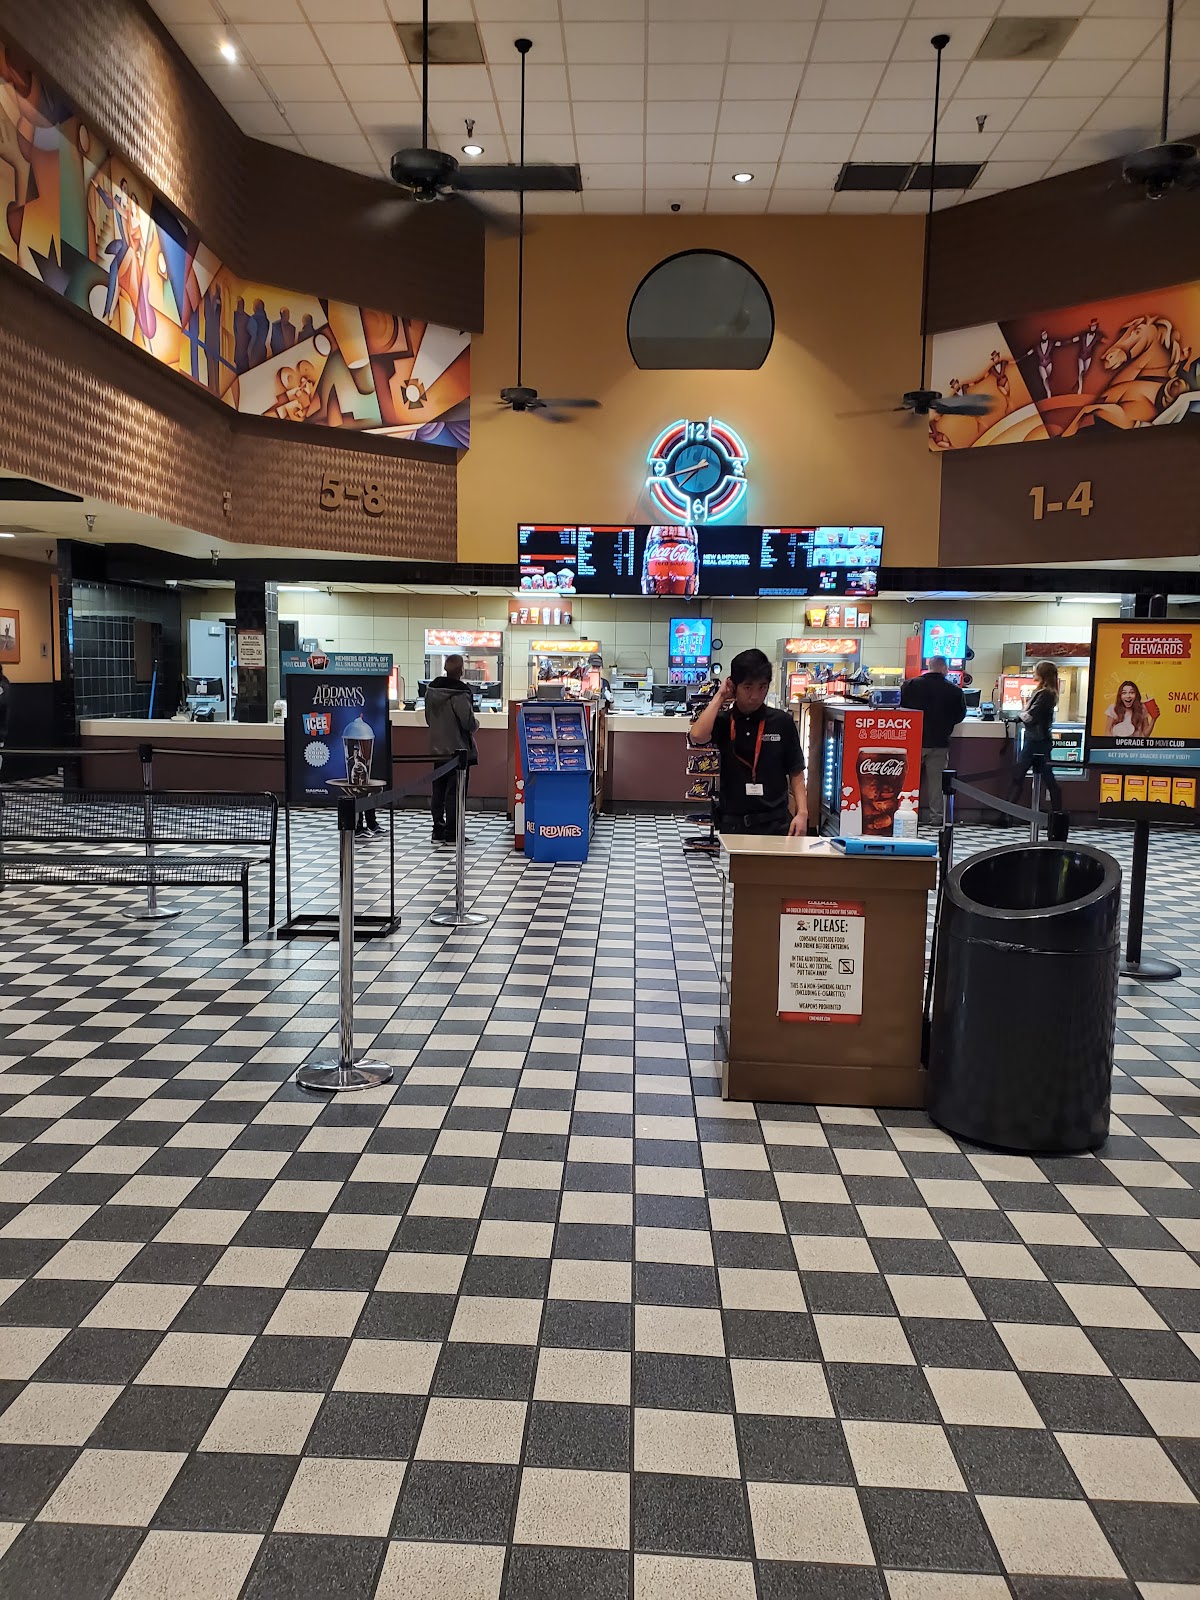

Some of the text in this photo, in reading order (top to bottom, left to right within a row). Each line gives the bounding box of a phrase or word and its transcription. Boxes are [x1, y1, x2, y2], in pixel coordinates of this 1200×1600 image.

[689, 422, 704, 438] 12
[654, 461, 666, 476] 9
[733, 460, 744, 476] 3
[321, 473, 385, 517] 5-8
[1028, 481, 1094, 520] 1-4
[693, 498, 704, 514] 6
[648, 544, 696, 562] Coca-Cola
[1134, 644, 1183, 655] REWARDS
[312, 686, 365, 706] ADDAMS
[1168, 692, 1199, 701] SNACK
[1174, 704, 1190, 713] ON!
[306, 717, 328, 730] ICEE
[856, 718, 911, 729] SIP BACK
[858, 729, 907, 740] & SMILE
[860, 759, 905, 776] Coca-Cola
[814, 919, 848, 932] PLEASE:
